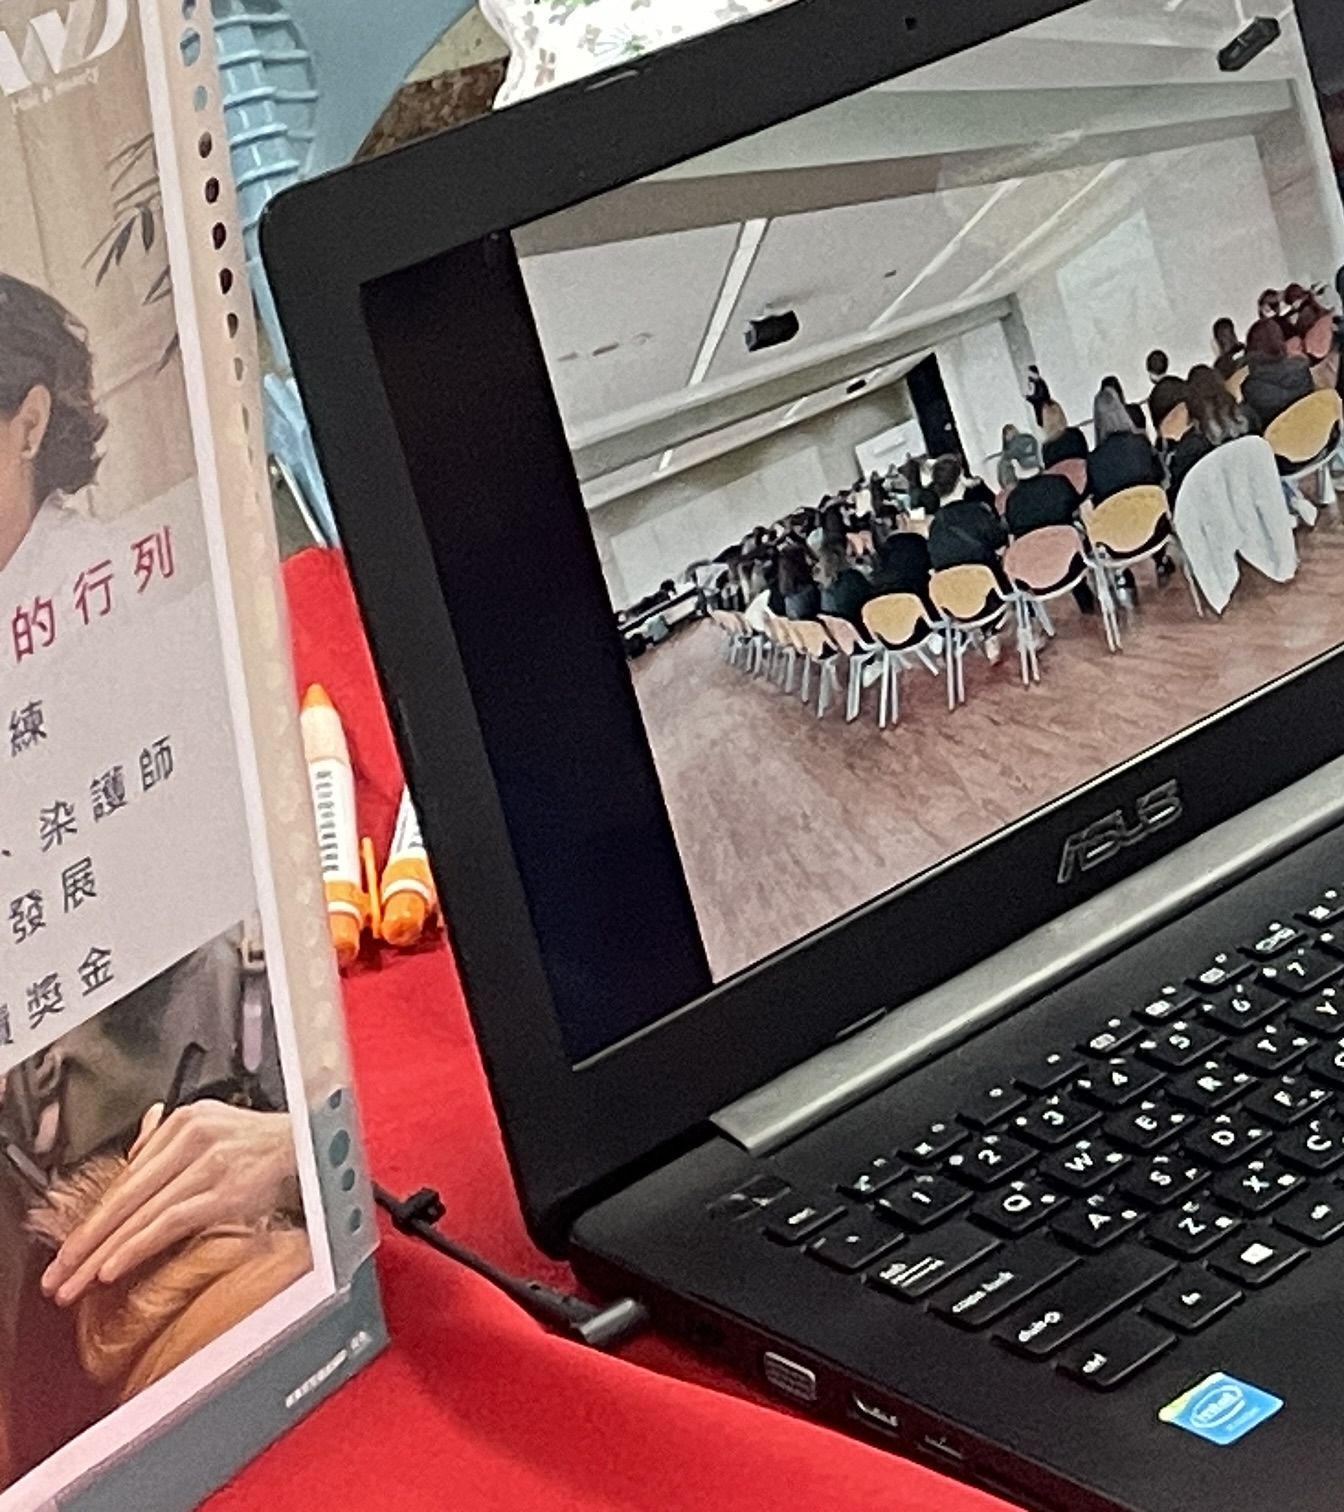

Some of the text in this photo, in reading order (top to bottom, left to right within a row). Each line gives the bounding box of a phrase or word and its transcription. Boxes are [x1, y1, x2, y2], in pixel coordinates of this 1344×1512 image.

[11, 524, 174, 664] 的行列
[1056, 778, 1184, 884] ASUS
[9, 856, 97, 944] 發展
